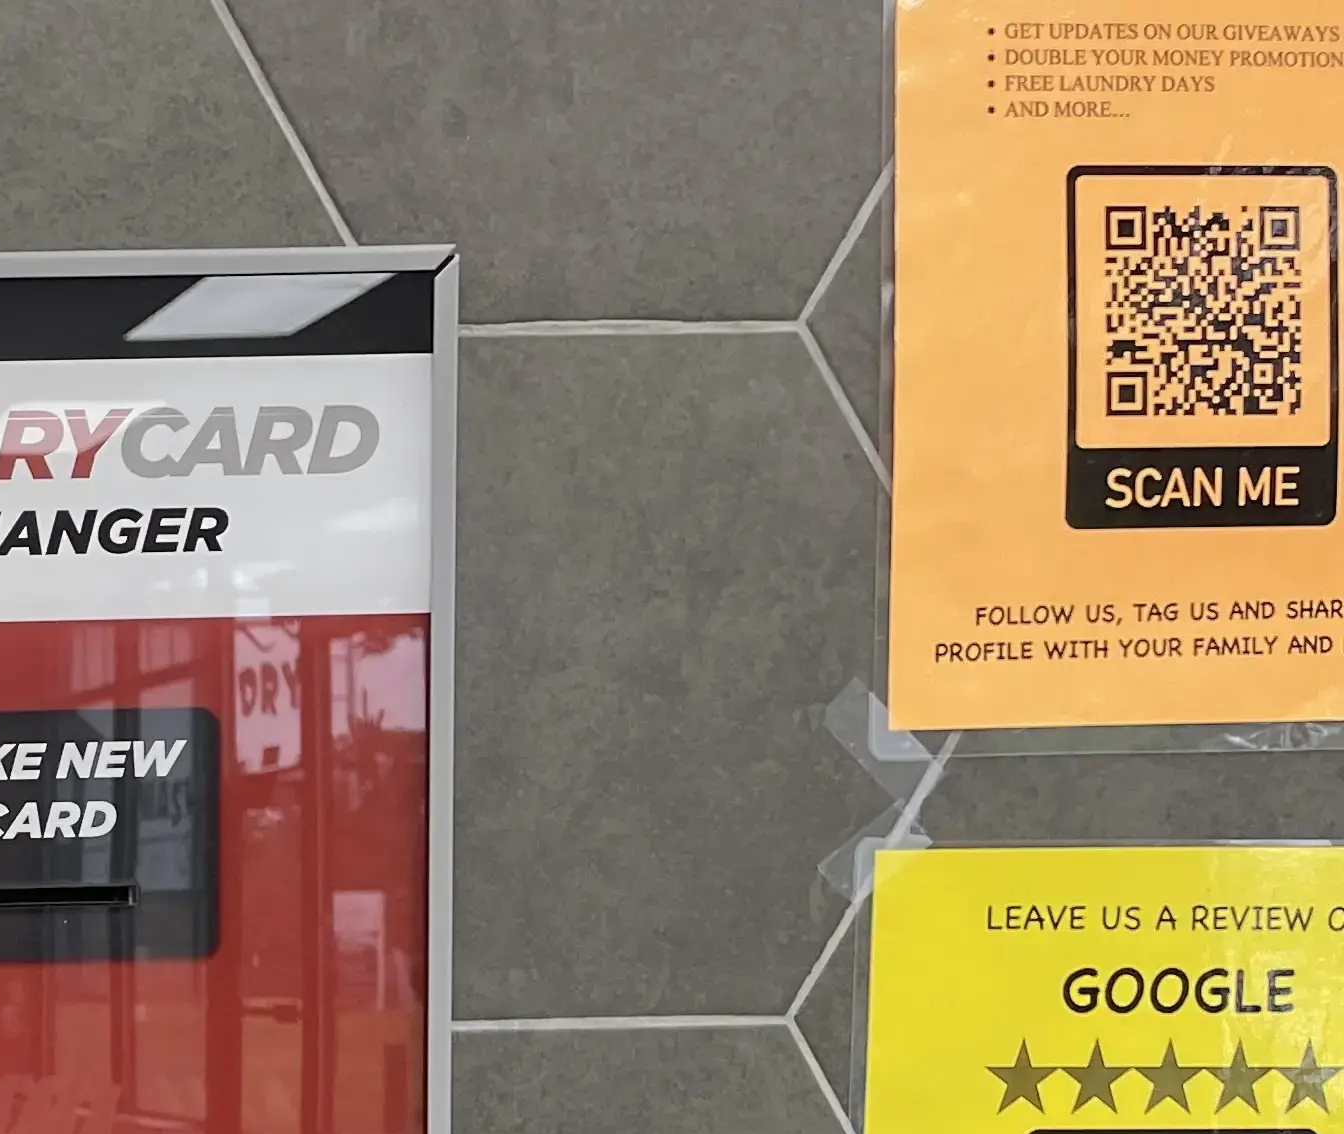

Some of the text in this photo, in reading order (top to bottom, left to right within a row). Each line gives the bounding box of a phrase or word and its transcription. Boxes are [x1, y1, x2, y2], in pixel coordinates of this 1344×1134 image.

[1004, 23, 1341, 42] GET UPDATES ON OUR GIVEAWAYS
[1004, 49, 1344, 68] DOUBLE YOUR MONEY PROMOTION
[1004, 75, 1215, 93] FREE LAUNDRY DAYS
[1004, 101, 1049, 118] AND
[1105, 466, 1301, 509] SCAN ME
[975, 604, 1075, 626] FOLLOW
[1086, 603, 1123, 627] US,
[1133, 602, 1179, 622] TAG
[1190, 602, 1219, 621] US
[1229, 600, 1275, 620] AND
[935, 635, 1333, 663] PROFILE WITH YOUR FAMILY AND
[55, 738, 187, 783] NEW
[986, 905, 1086, 931] LEAVE
[1102, 905, 1141, 931] US
[1155, 905, 1177, 931] A
[1191, 905, 1314, 932] REVIEW
[1062, 968, 1295, 1014] GOOGLE
